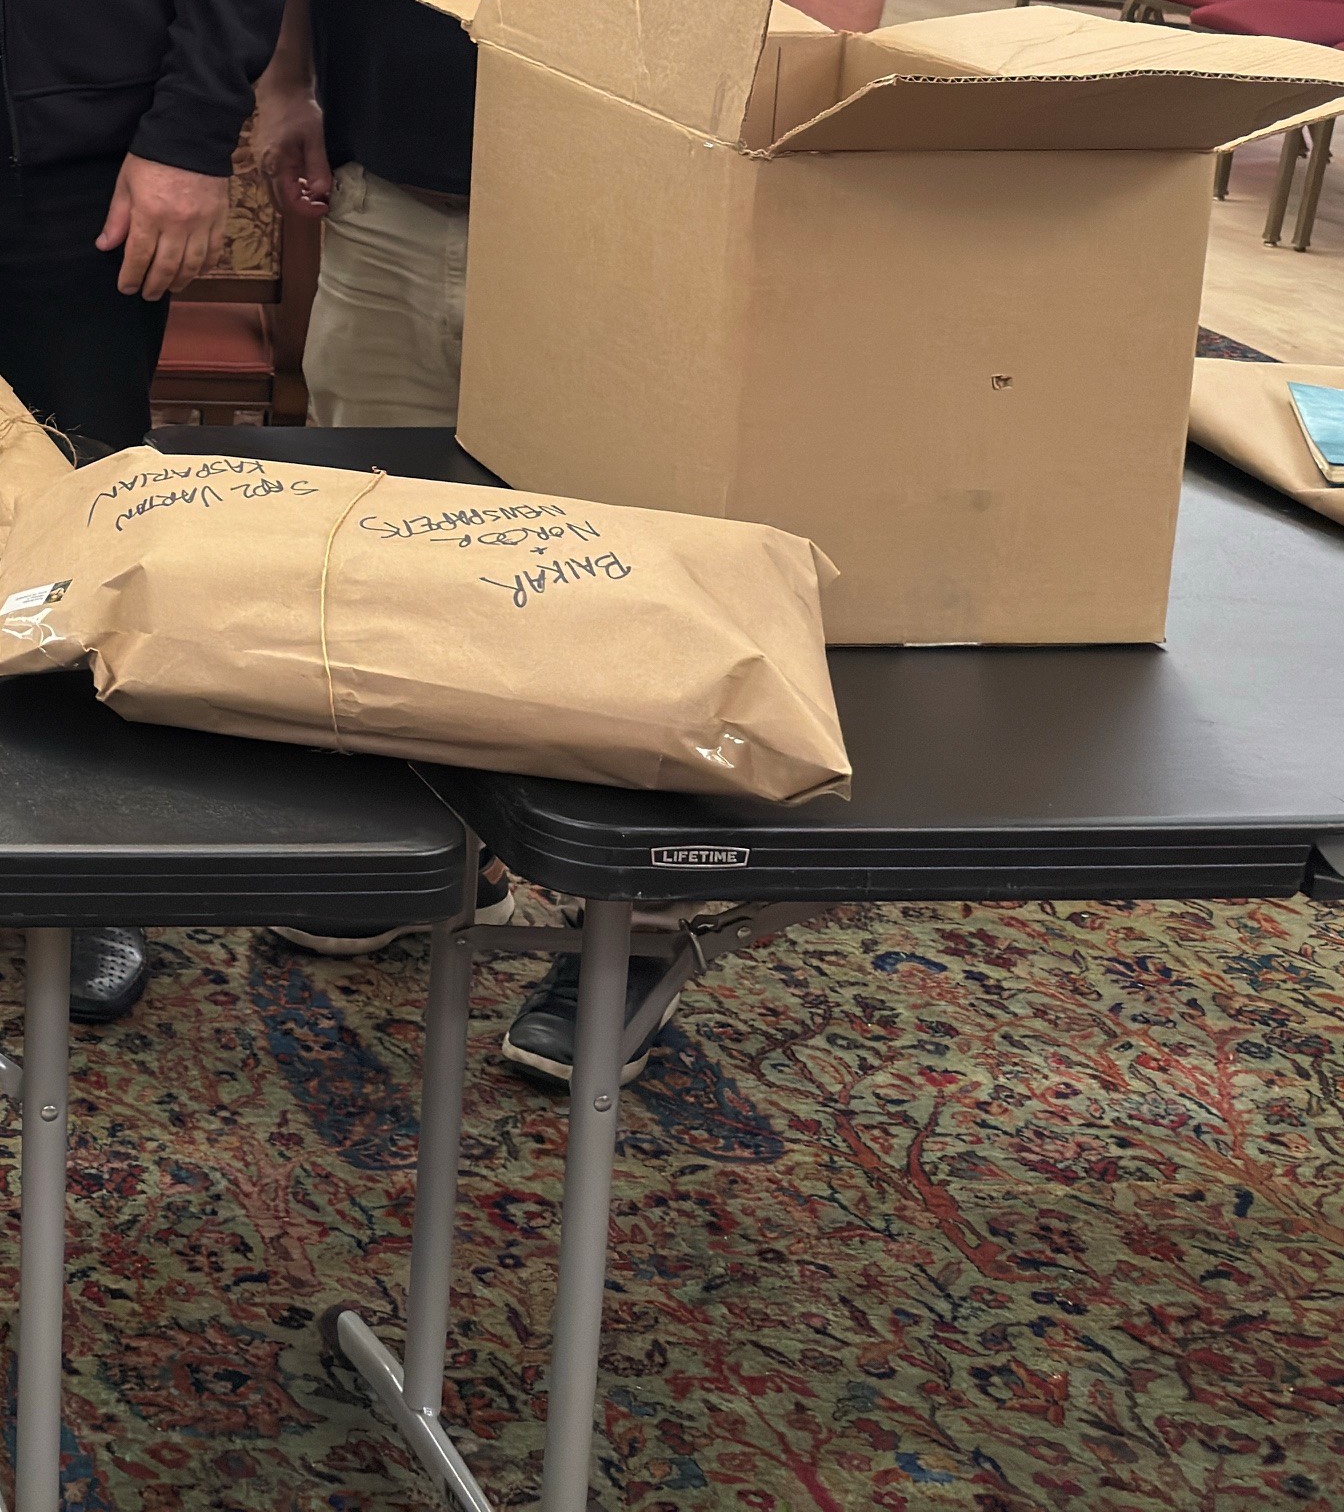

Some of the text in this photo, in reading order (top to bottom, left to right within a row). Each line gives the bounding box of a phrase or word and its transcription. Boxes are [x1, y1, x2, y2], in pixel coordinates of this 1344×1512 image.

[86, 459, 266, 528] KASPARIAN
[115, 485, 224, 532] VARTAN
[359, 503, 568, 539] NEWSPAPERS
[478, 551, 632, 609] BAIKAR
[662, 850, 738, 863] LIFETIME
